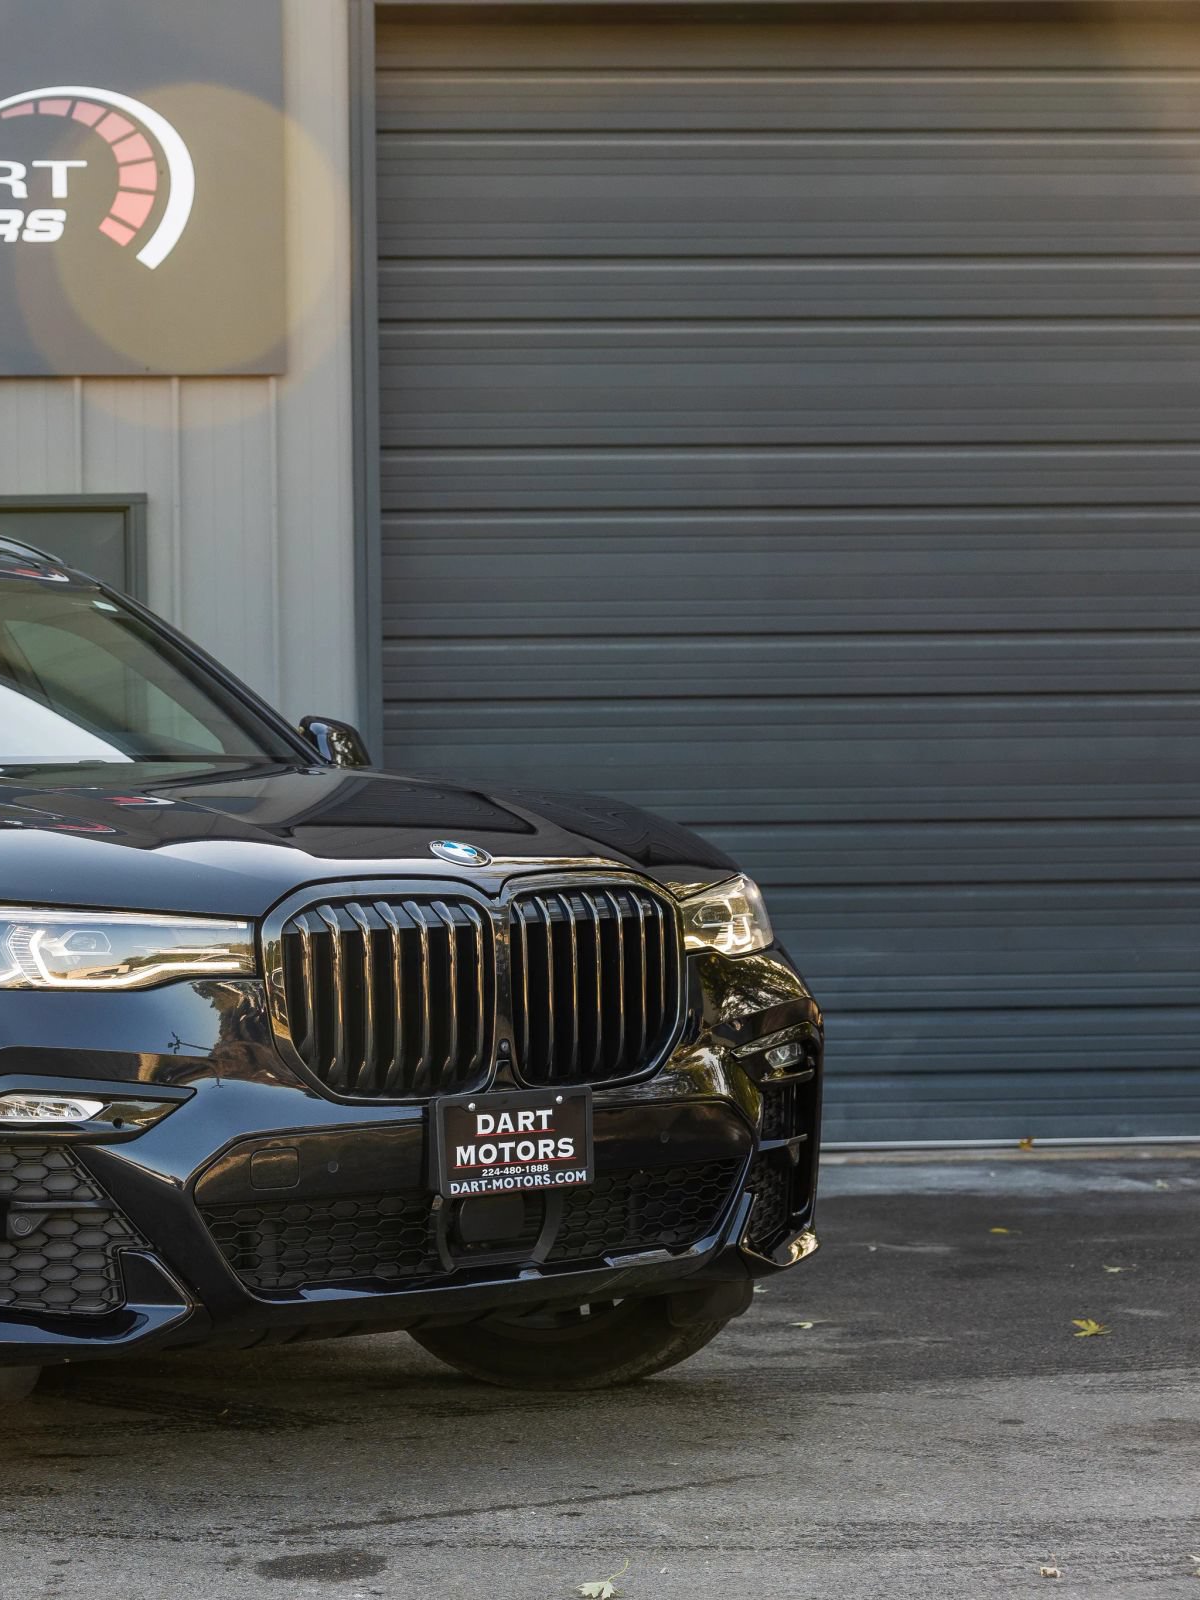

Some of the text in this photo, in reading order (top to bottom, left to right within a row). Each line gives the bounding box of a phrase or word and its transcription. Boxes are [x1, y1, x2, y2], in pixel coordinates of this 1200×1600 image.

[476, 1108, 553, 1135] DART
[456, 1137, 575, 1167] MOTORS
[450, 1170, 587, 1195] DART-MOTORS.COM
[482, 1164, 549, 1177] 224-480-1888
